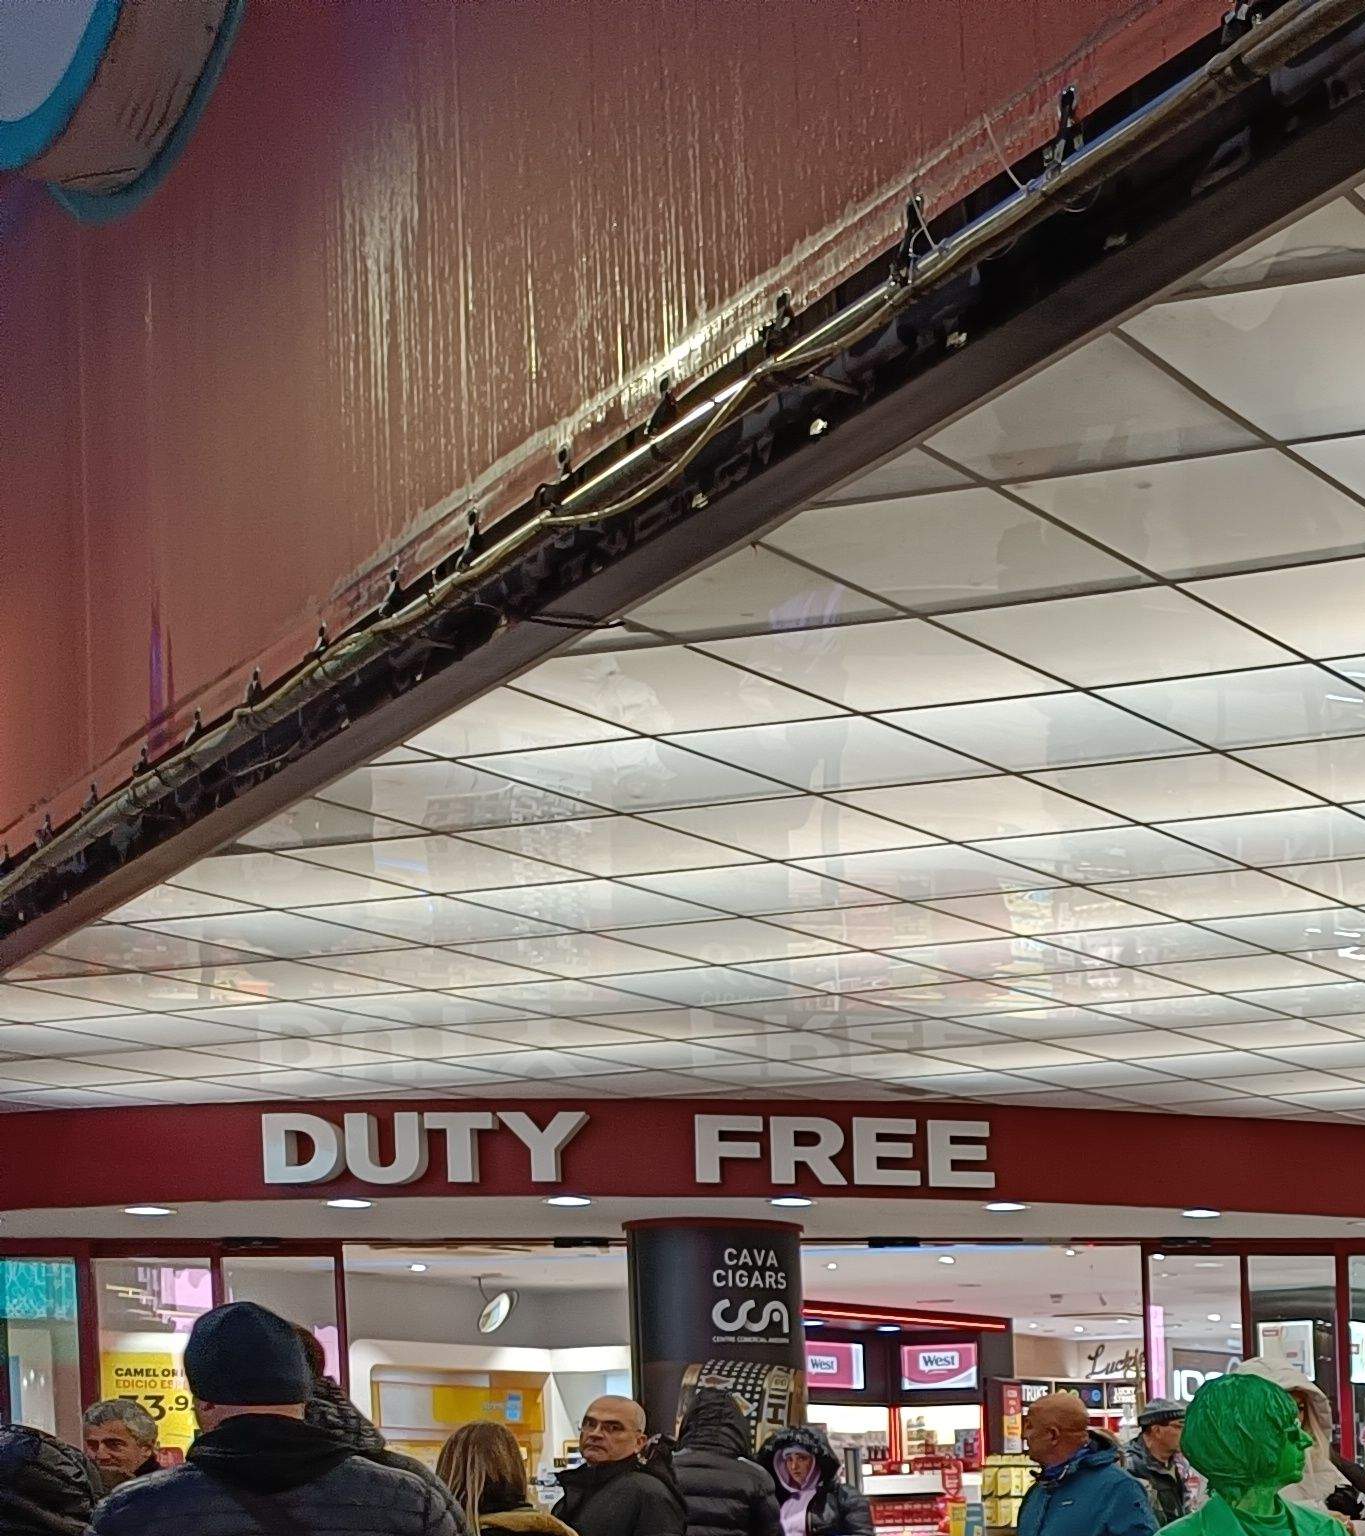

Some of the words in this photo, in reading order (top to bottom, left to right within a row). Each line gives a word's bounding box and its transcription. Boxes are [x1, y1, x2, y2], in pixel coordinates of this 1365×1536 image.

[262, 1111, 590, 1184] DUTY
[694, 1113, 996, 1188] FREE
[723, 1247, 779, 1268] CAVA
[712, 1269, 787, 1290] CIGARS
[810, 1358, 835, 1371] West
[922, 1354, 956, 1368] West
[114, 1368, 159, 1378] CAMEL
